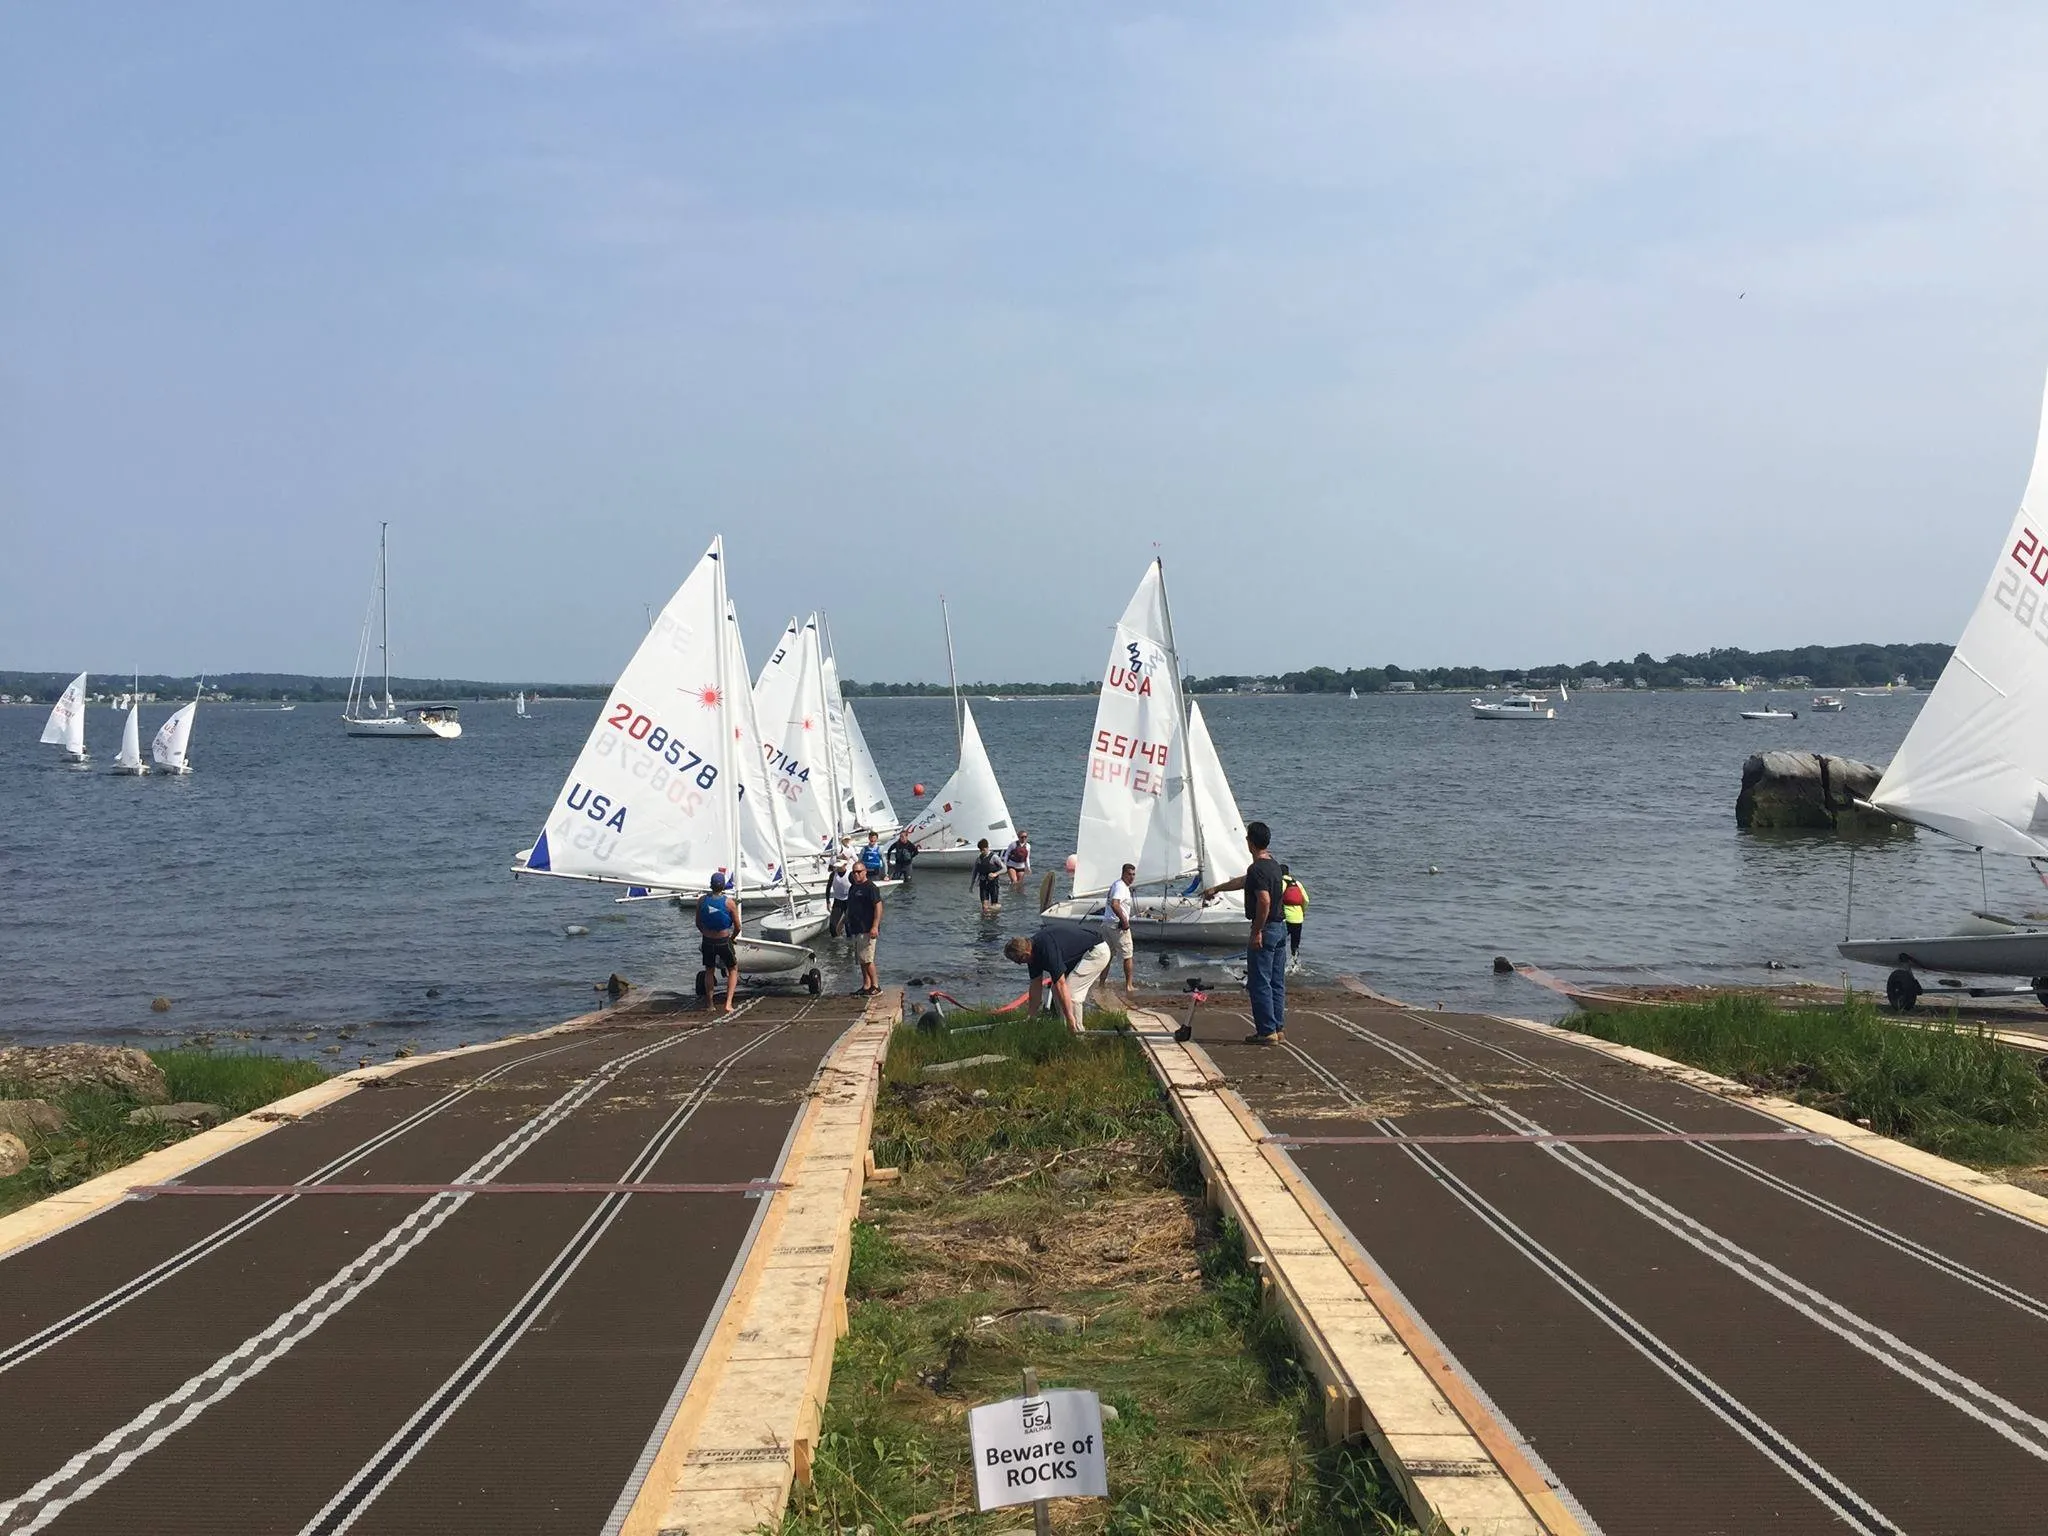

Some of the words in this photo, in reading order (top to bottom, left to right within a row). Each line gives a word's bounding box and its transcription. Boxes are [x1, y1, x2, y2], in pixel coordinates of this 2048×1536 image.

[1109, 665, 1152, 697] USA
[607, 703, 719, 790] 208578
[1095, 730, 1168, 766] 55148
[566, 782, 627, 833] USA
[1024, 1425, 1052, 1435] SAILING
[986, 1439, 1065, 1466] Beware
[1072, 1435, 1094, 1455] of
[1007, 1460, 1078, 1488] ROCKS
